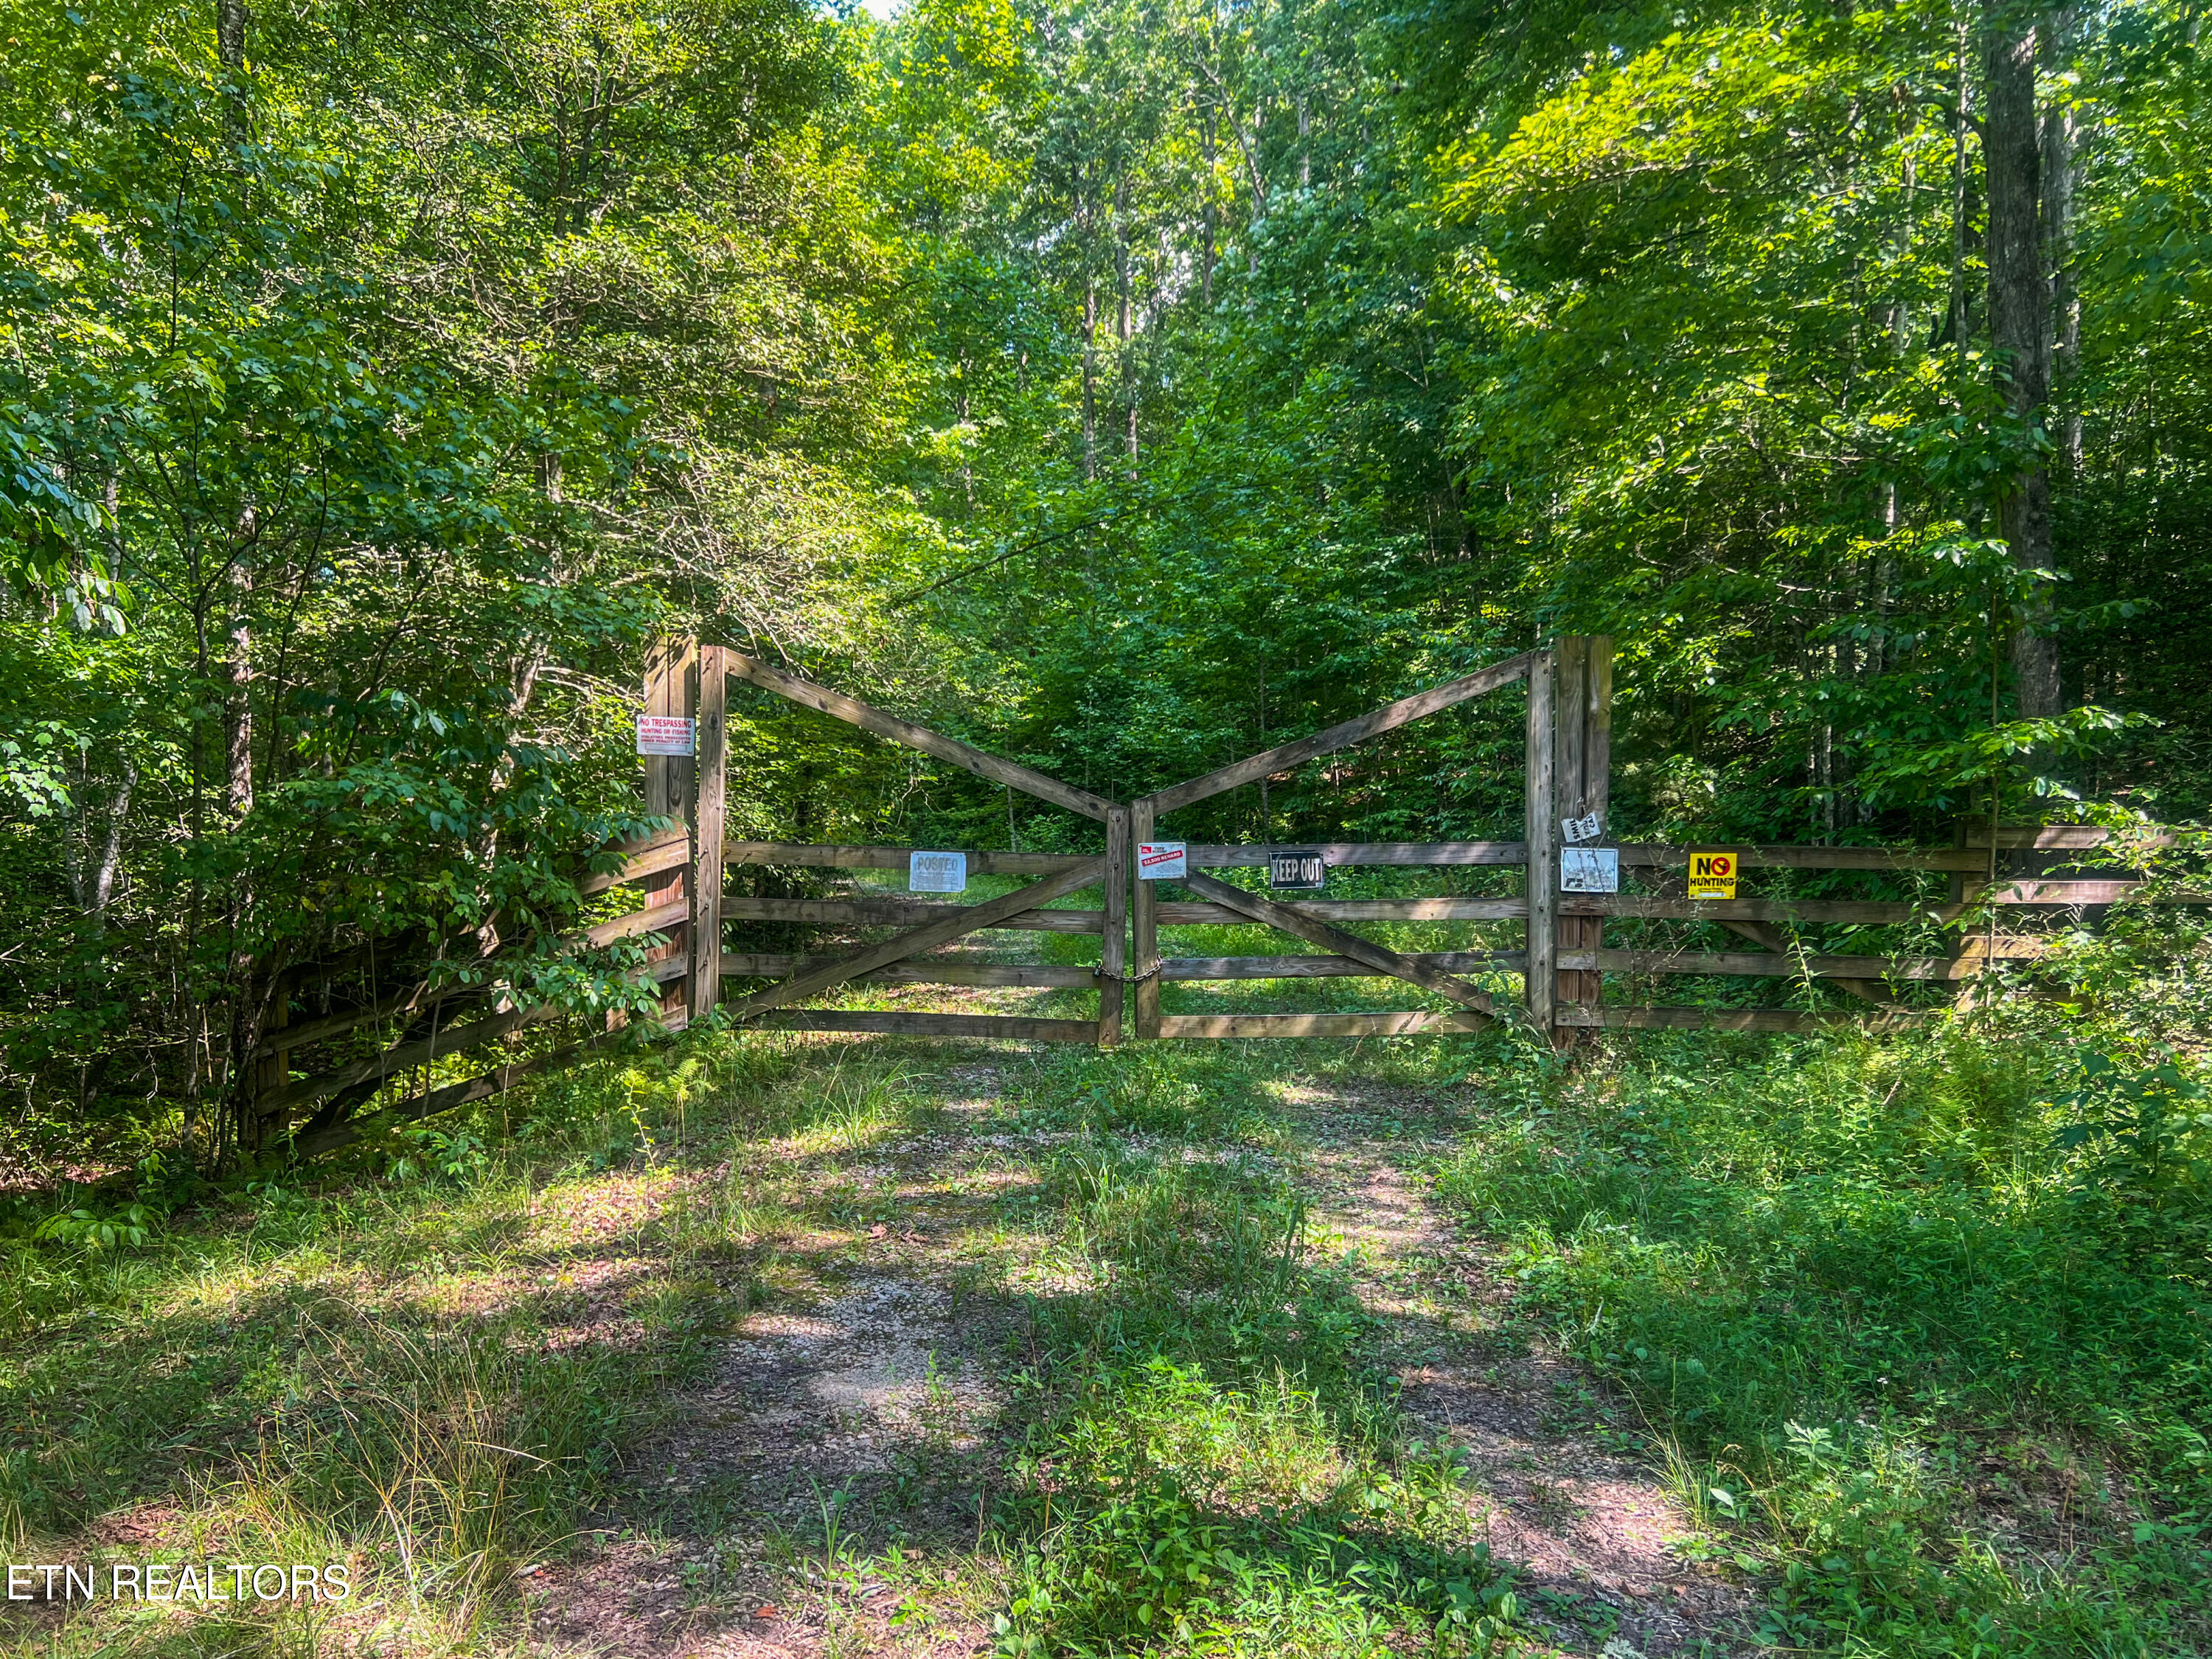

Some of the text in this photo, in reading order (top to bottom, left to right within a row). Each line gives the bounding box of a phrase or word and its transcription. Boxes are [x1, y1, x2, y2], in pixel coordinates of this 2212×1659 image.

[641, 718, 692, 728] NO TRESPASSING
[917, 856, 959, 872] POSTED
[1272, 858, 1321, 882] KEEP OUT
[1690, 877, 1735, 887] HUNTING
